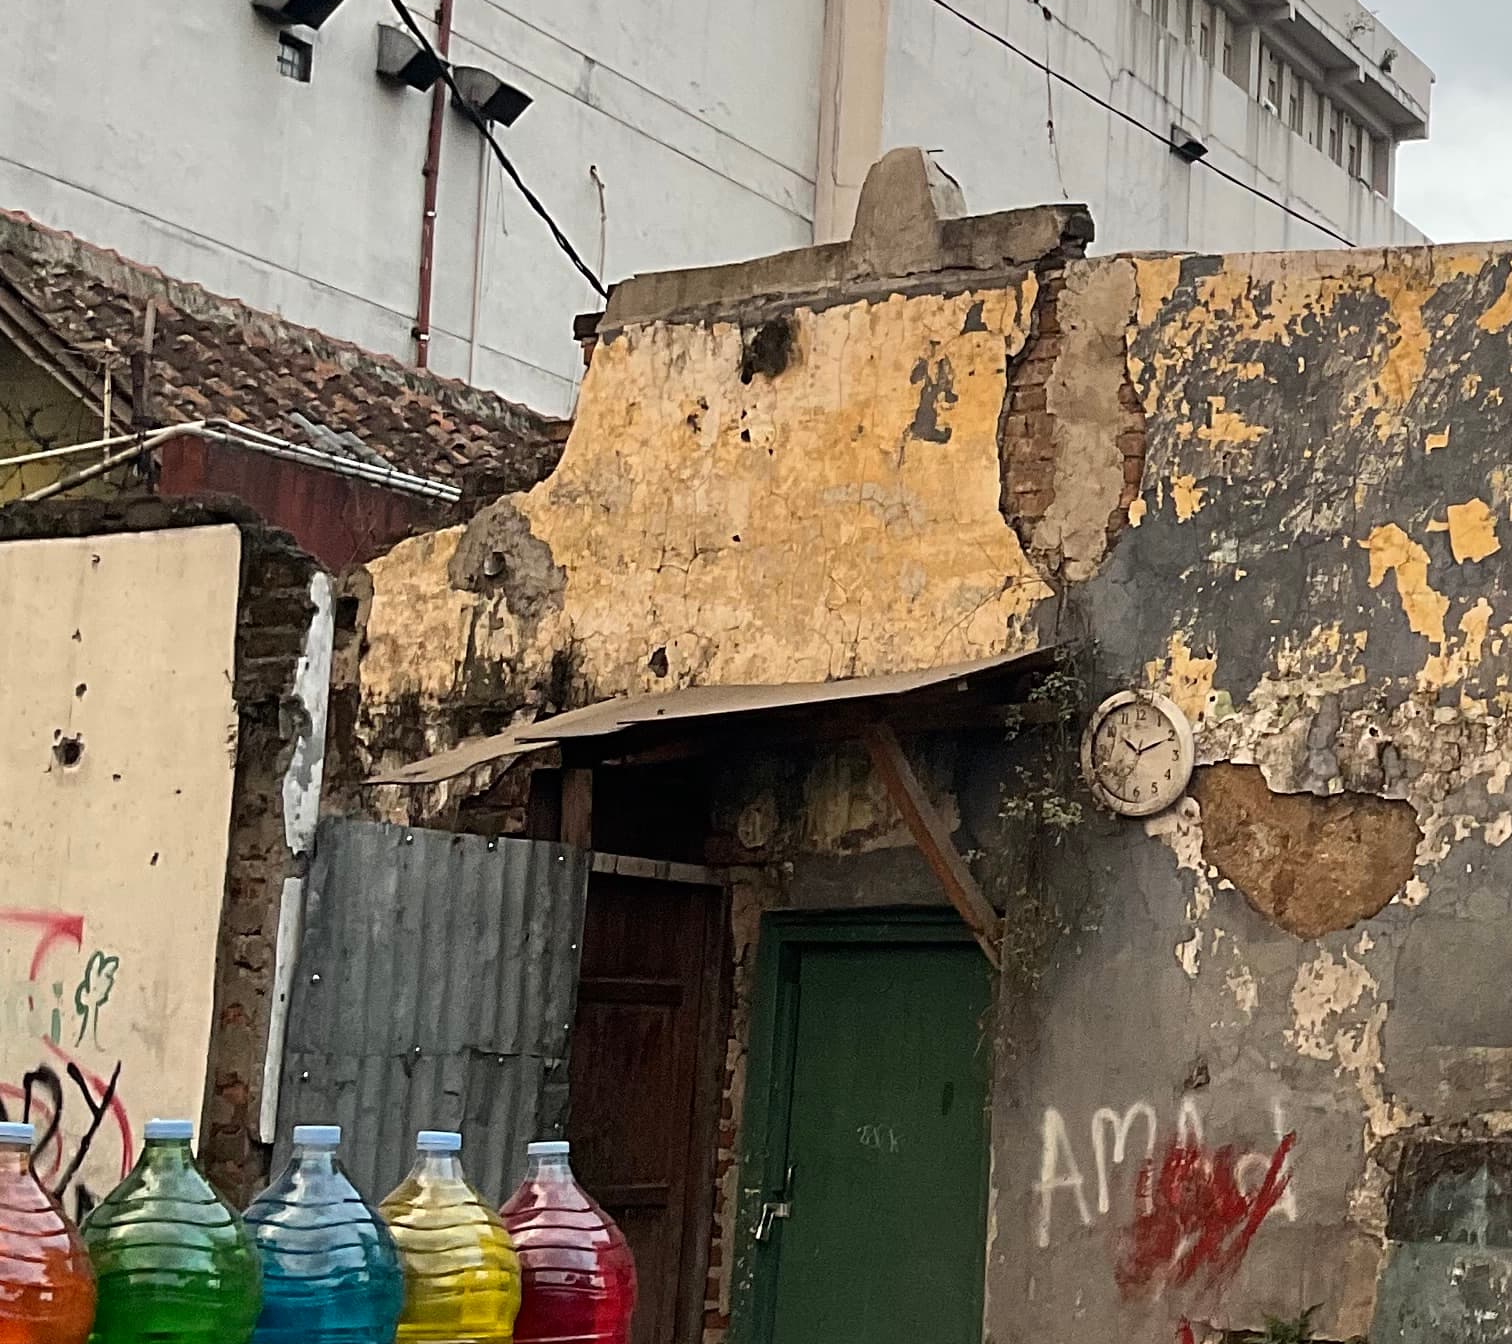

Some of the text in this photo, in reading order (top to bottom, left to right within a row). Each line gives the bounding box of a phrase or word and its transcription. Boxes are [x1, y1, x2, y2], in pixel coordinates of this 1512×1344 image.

[1121, 712, 1130, 725] 11
[1136, 708, 1147, 721] 12
[1167, 729, 1176, 742] 2
[1171, 749, 1180, 762] 3
[1163, 768, 1172, 780] 4
[1132, 785, 1141, 799] 6
[1150, 781, 1159, 794] 5
